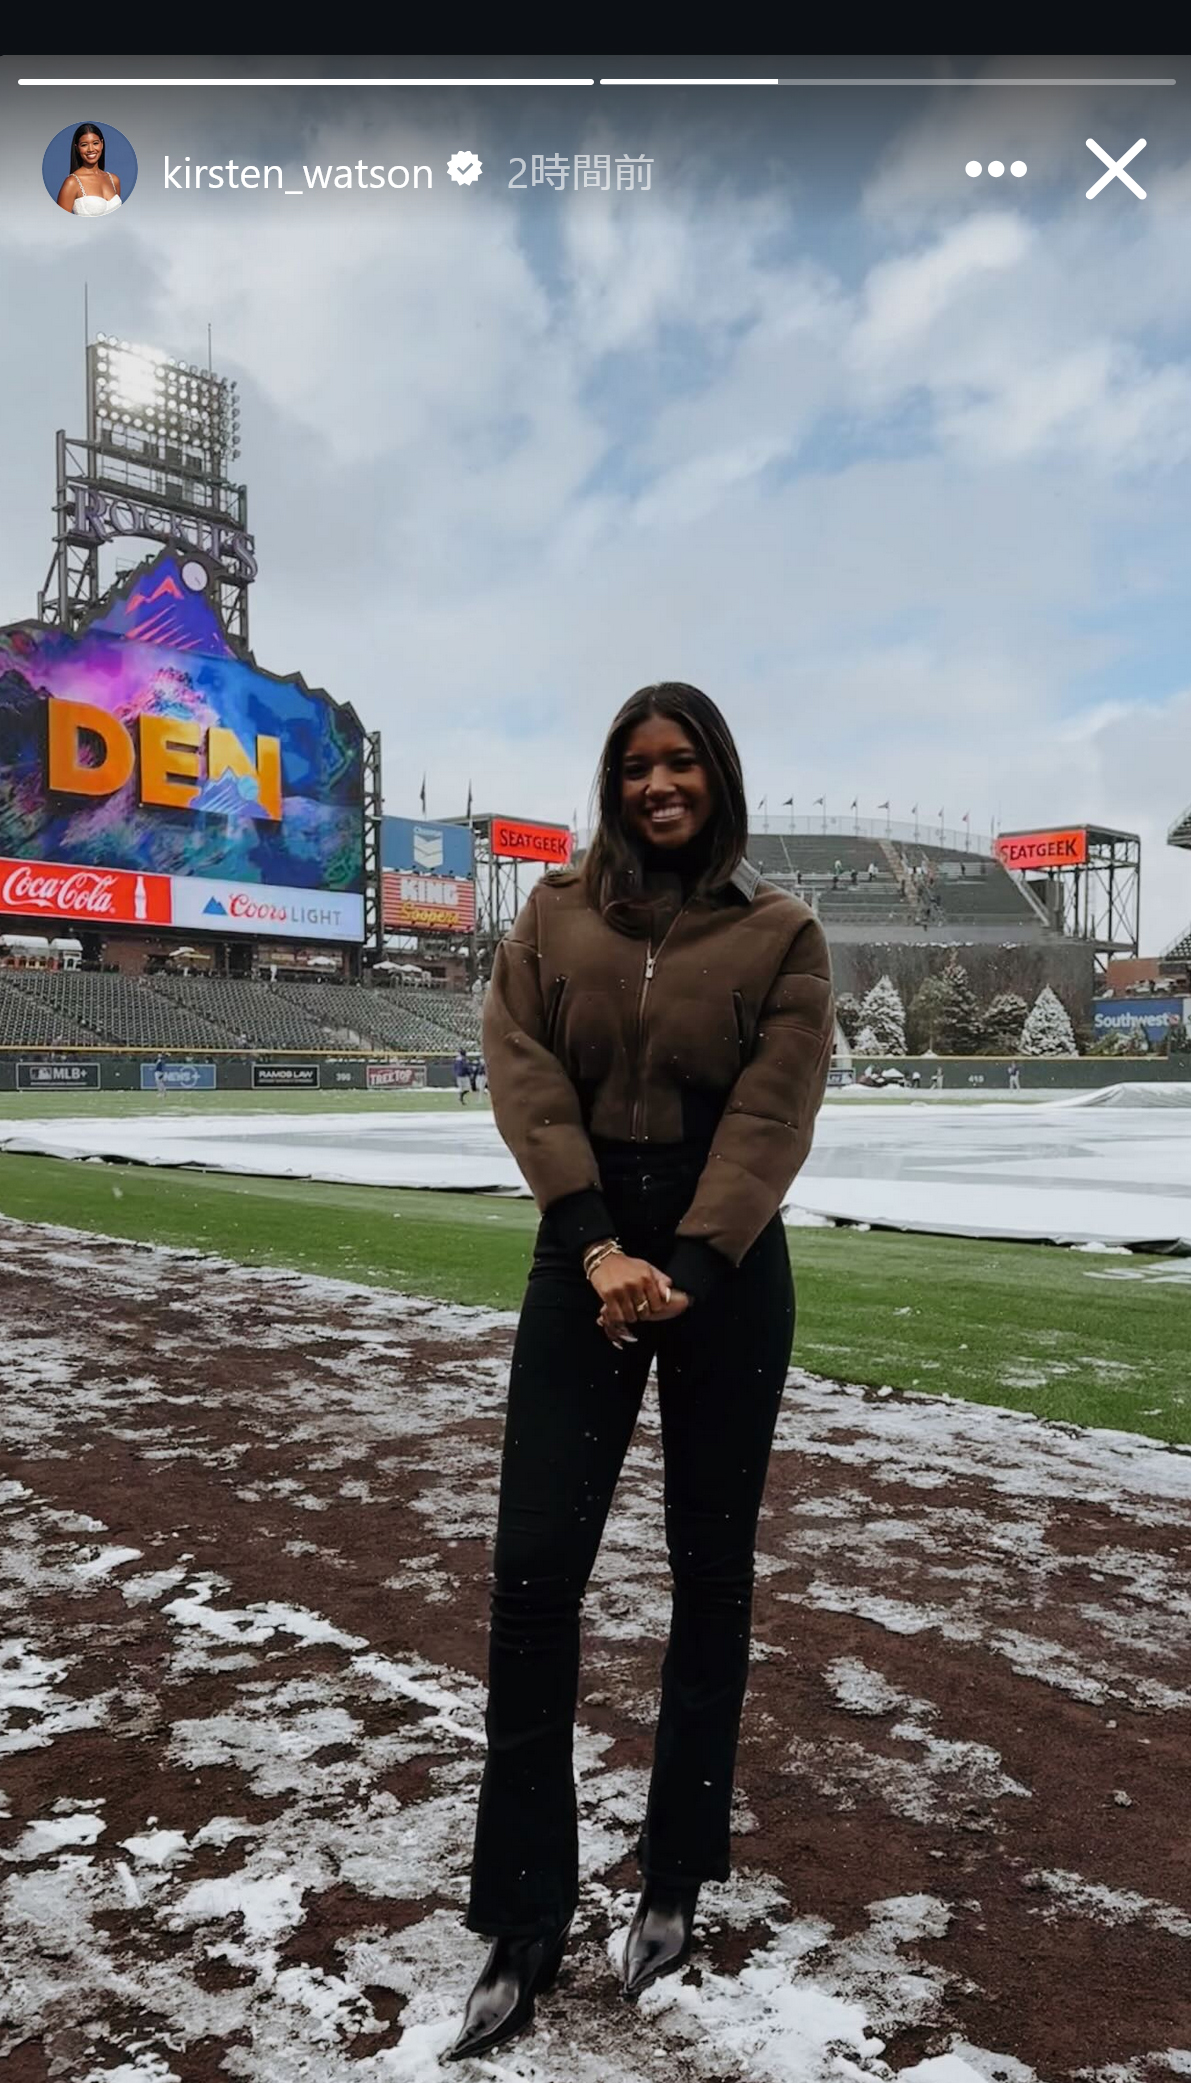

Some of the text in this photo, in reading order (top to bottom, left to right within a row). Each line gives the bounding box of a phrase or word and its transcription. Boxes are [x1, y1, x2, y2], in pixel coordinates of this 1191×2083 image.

[72, 487, 258, 579] ROCKIES
[48, 697, 282, 822] DEN
[499, 828, 568, 856] SEATGEEK
[1000, 837, 1078, 863] SEATGEEK
[2, 866, 113, 913] Coca-Cola
[229, 893, 341, 926] Coors LIGHT
[1094, 1012, 1169, 1028] Southwest
